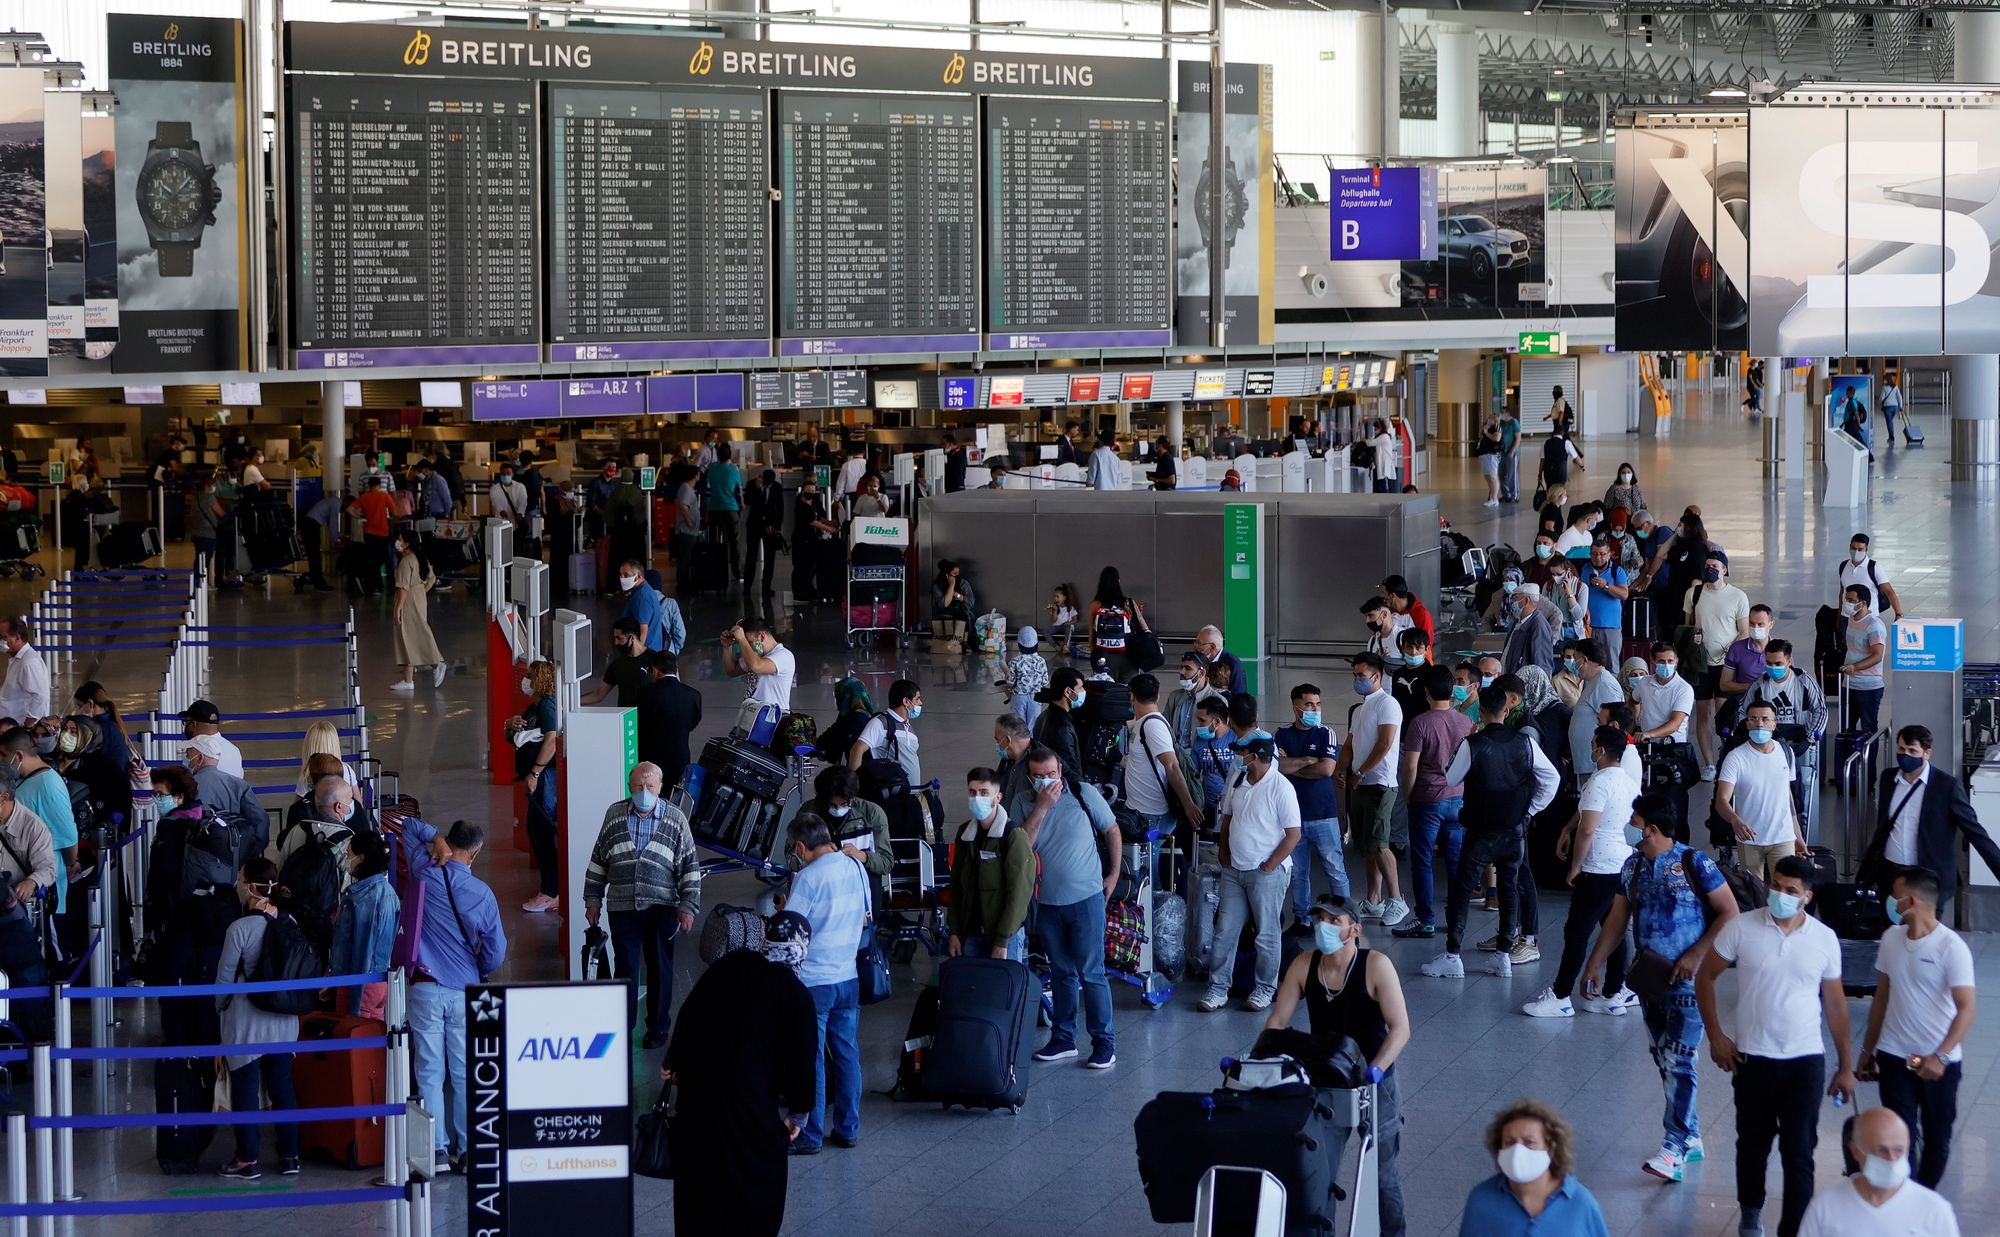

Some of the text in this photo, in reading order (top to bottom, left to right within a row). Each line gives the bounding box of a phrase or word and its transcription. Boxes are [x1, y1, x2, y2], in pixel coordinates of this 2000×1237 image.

[133, 42, 212, 57] BREITLING
[441, 40, 592, 68] BREITLING
[160, 58, 183, 68] 1884
[722, 50, 857, 79] BREITLING
[973, 61, 1094, 87] BREITLING
[1263, 64, 1273, 133] AVENGER
[352, 123, 408, 132] DUESSELDORF HBF
[1341, 175, 1370, 184] Terminal
[1341, 189, 1380, 198] Abflughalle
[1341, 200, 1378, 208] Departures
[1799, 141, 1991, 308] S
[1342, 220, 1360, 250] B
[177, 328, 204, 336] BOUTIQUE
[520, 384, 527, 397] C
[949, 387, 967, 396] 500-
[949, 398, 963, 406] 570
[518, 1037, 582, 1061] ANA
[475, 1036, 500, 1215] ALLIANCE
[534, 1115, 602, 1128] CHECK-IN
[536, 1128, 600, 1140] チェックイン
[547, 1157, 617, 1170] Lufthansa
